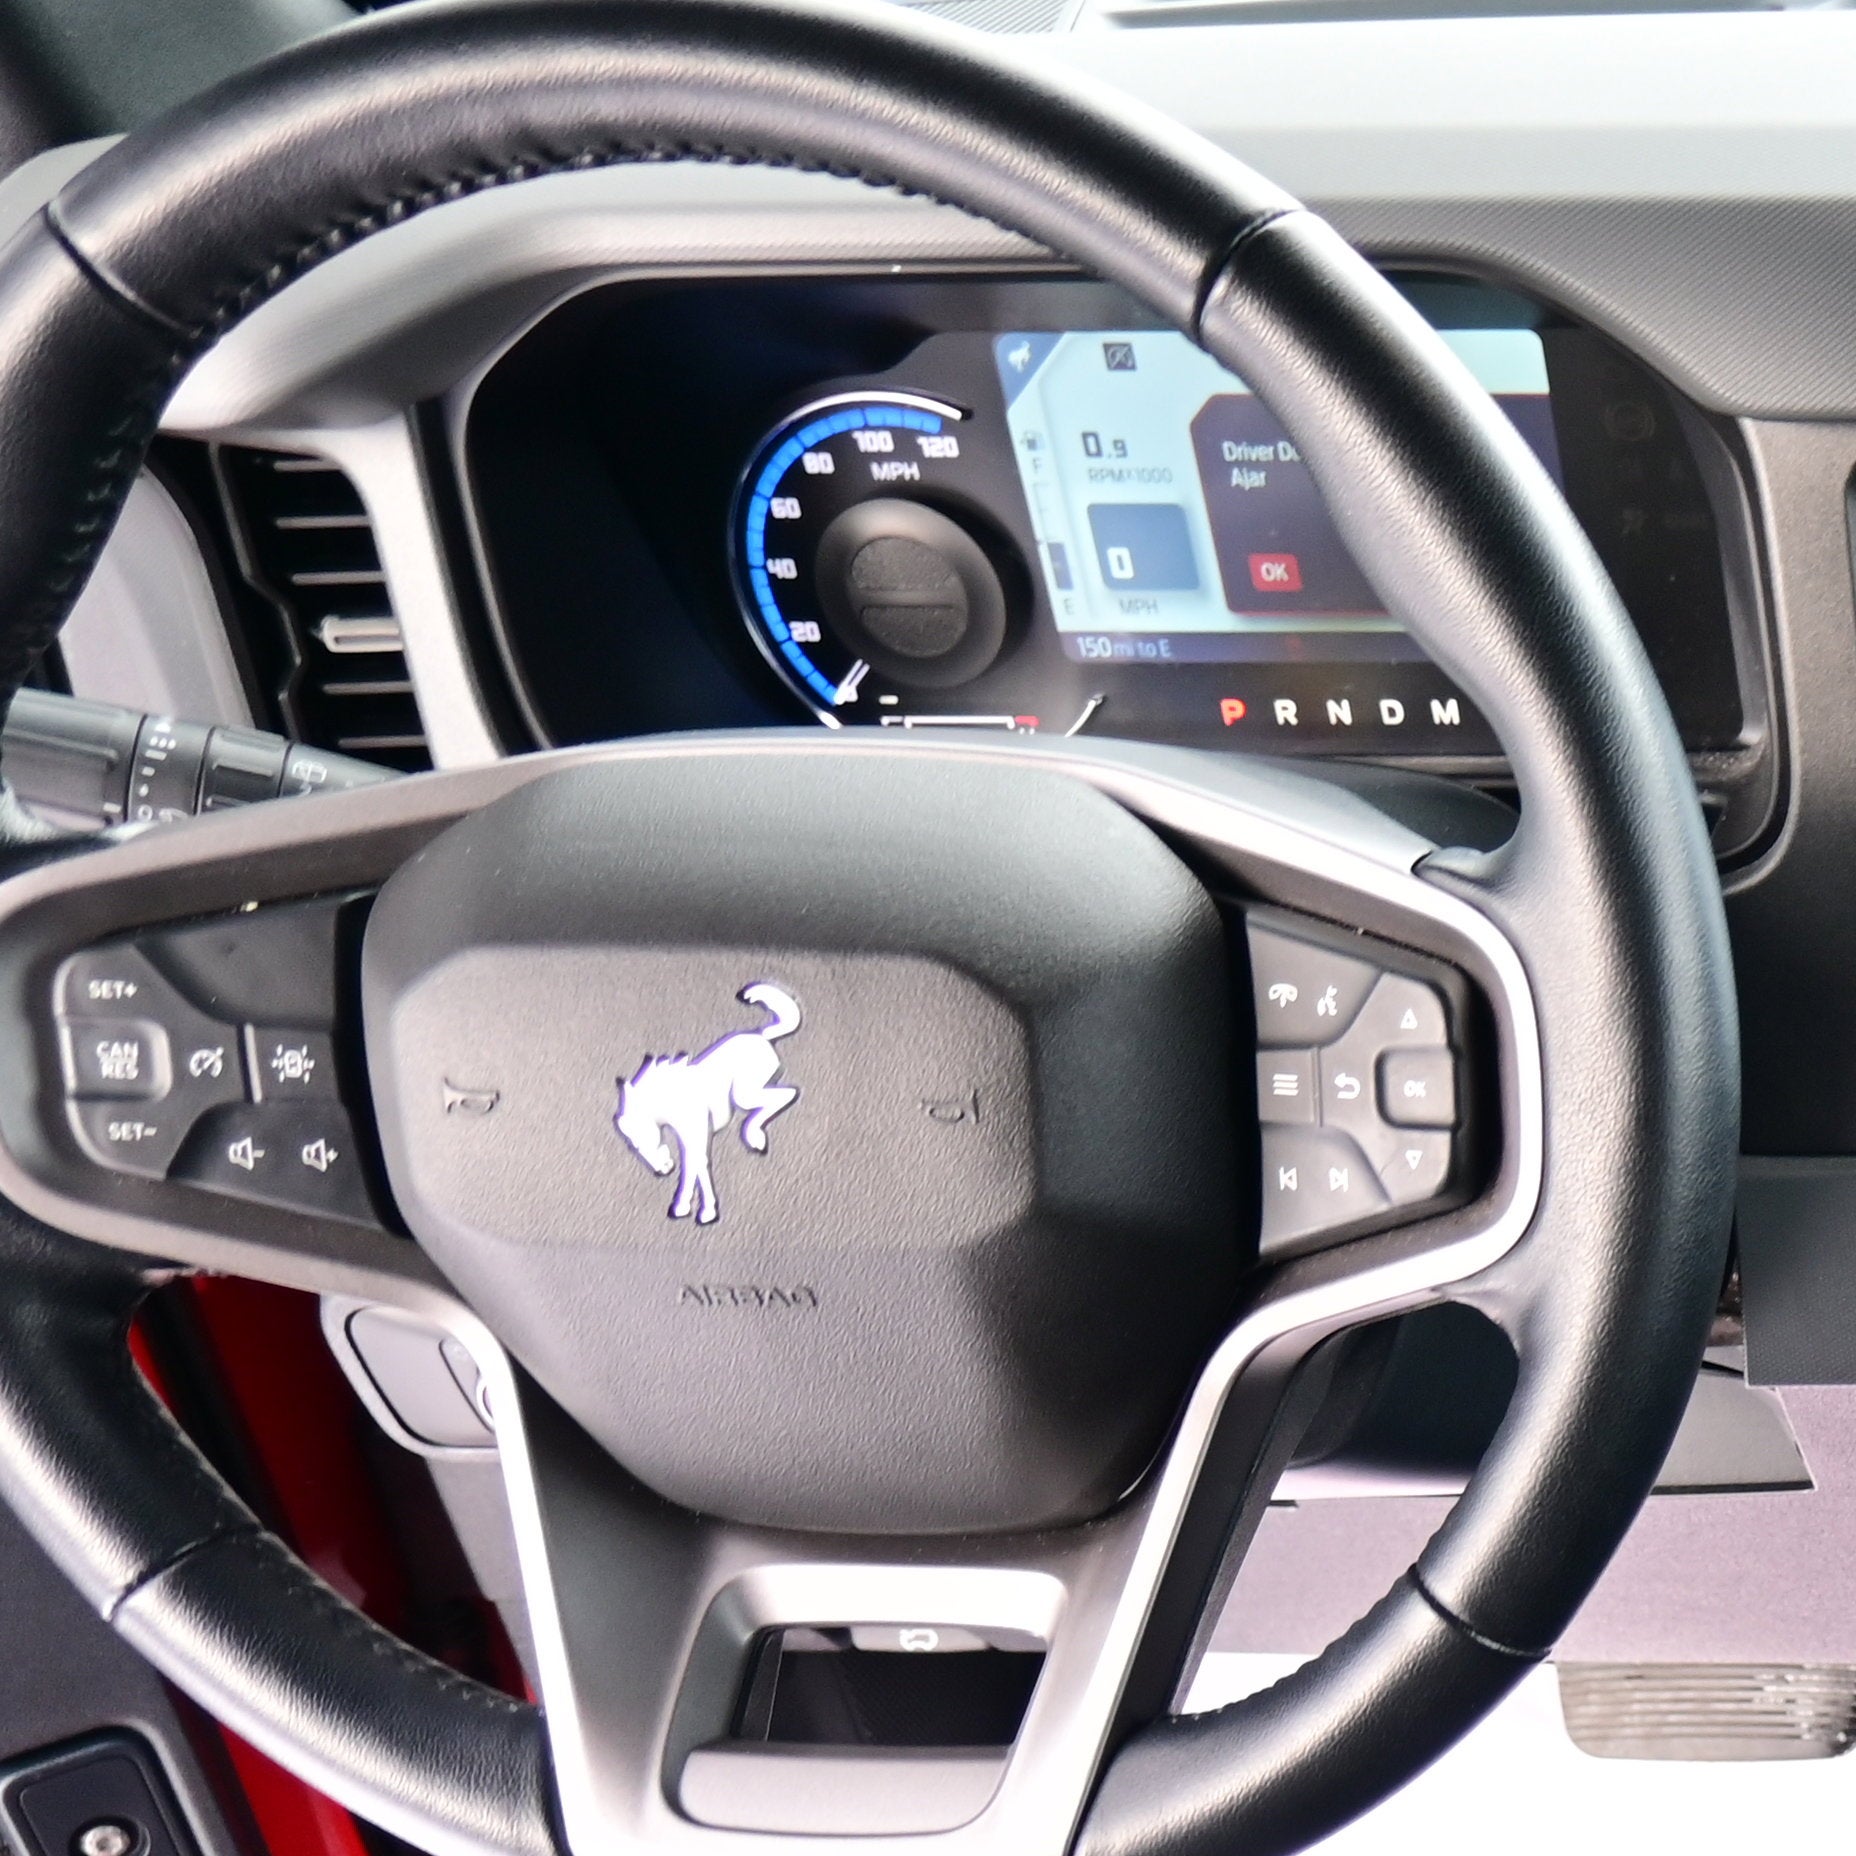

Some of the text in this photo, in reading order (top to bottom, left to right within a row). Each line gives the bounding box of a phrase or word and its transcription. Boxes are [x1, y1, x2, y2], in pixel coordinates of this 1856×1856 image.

[853, 431, 894, 453] 100
[916, 436, 960, 458] 120
[1082, 432, 1128, 458] 0.9
[1222, 441, 1274, 463] Driver
[802, 452, 835, 474] 80
[870, 461, 920, 481] MPH
[1231, 467, 1266, 491] Ajar
[770, 497, 802, 519] 60
[766, 557, 798, 579] 40
[1107, 547, 1134, 579] 0
[1261, 562, 1289, 582] OK
[1119, 598, 1159, 614] MPH
[789, 621, 821, 642] 20
[1077, 636, 1112, 658] 150
[1138, 641, 1157, 657] to
[1159, 639, 1172, 658] E
[1220, 698, 1461, 726] P R N D M
[89, 979, 138, 1000] SET+
[1403, 1080, 1427, 1100] OK
